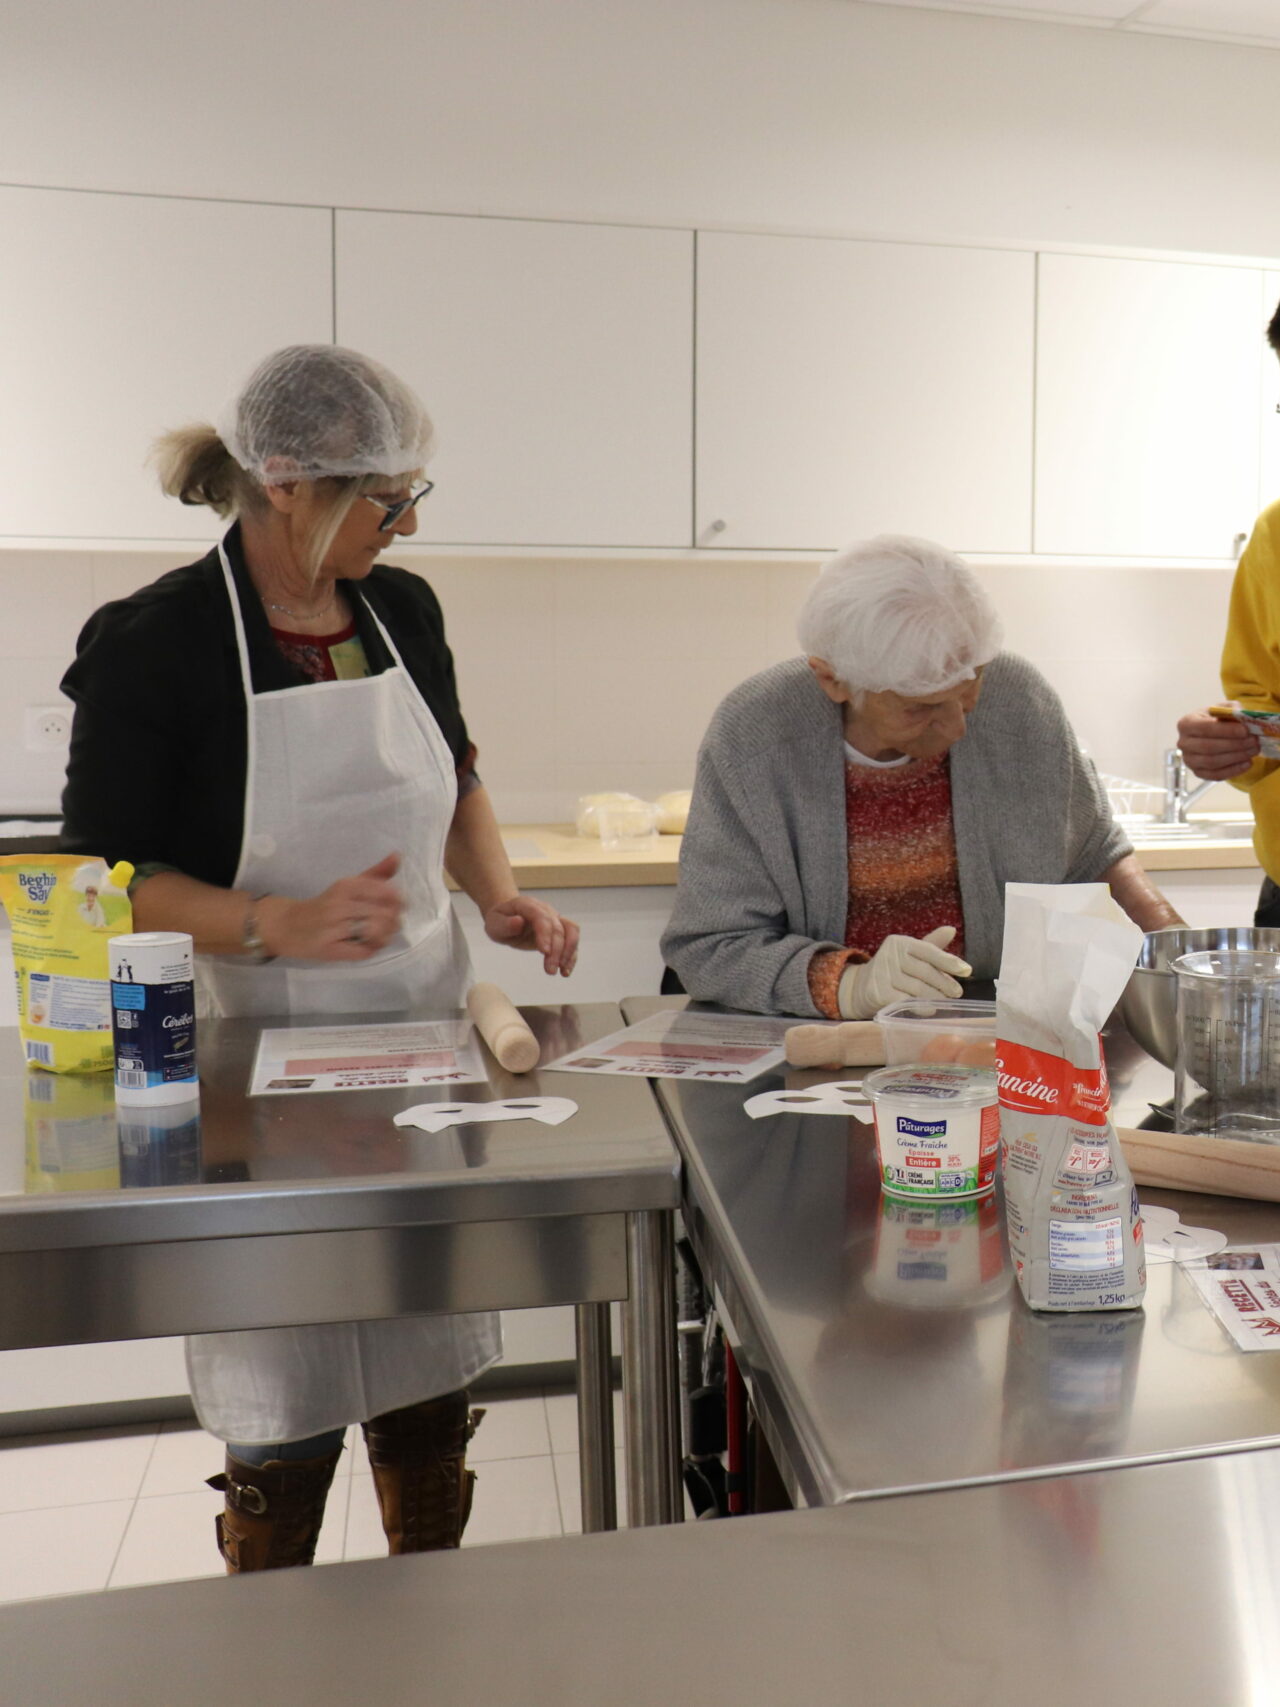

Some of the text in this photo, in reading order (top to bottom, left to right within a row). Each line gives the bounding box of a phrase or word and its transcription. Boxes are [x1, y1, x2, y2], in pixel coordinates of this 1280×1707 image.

[28, 886, 52, 904] Say
[899, 1119, 945, 1134] Pâturages
[908, 1158, 937, 1167] Entière
[1218, 1279, 1259, 1312] RECETTE
